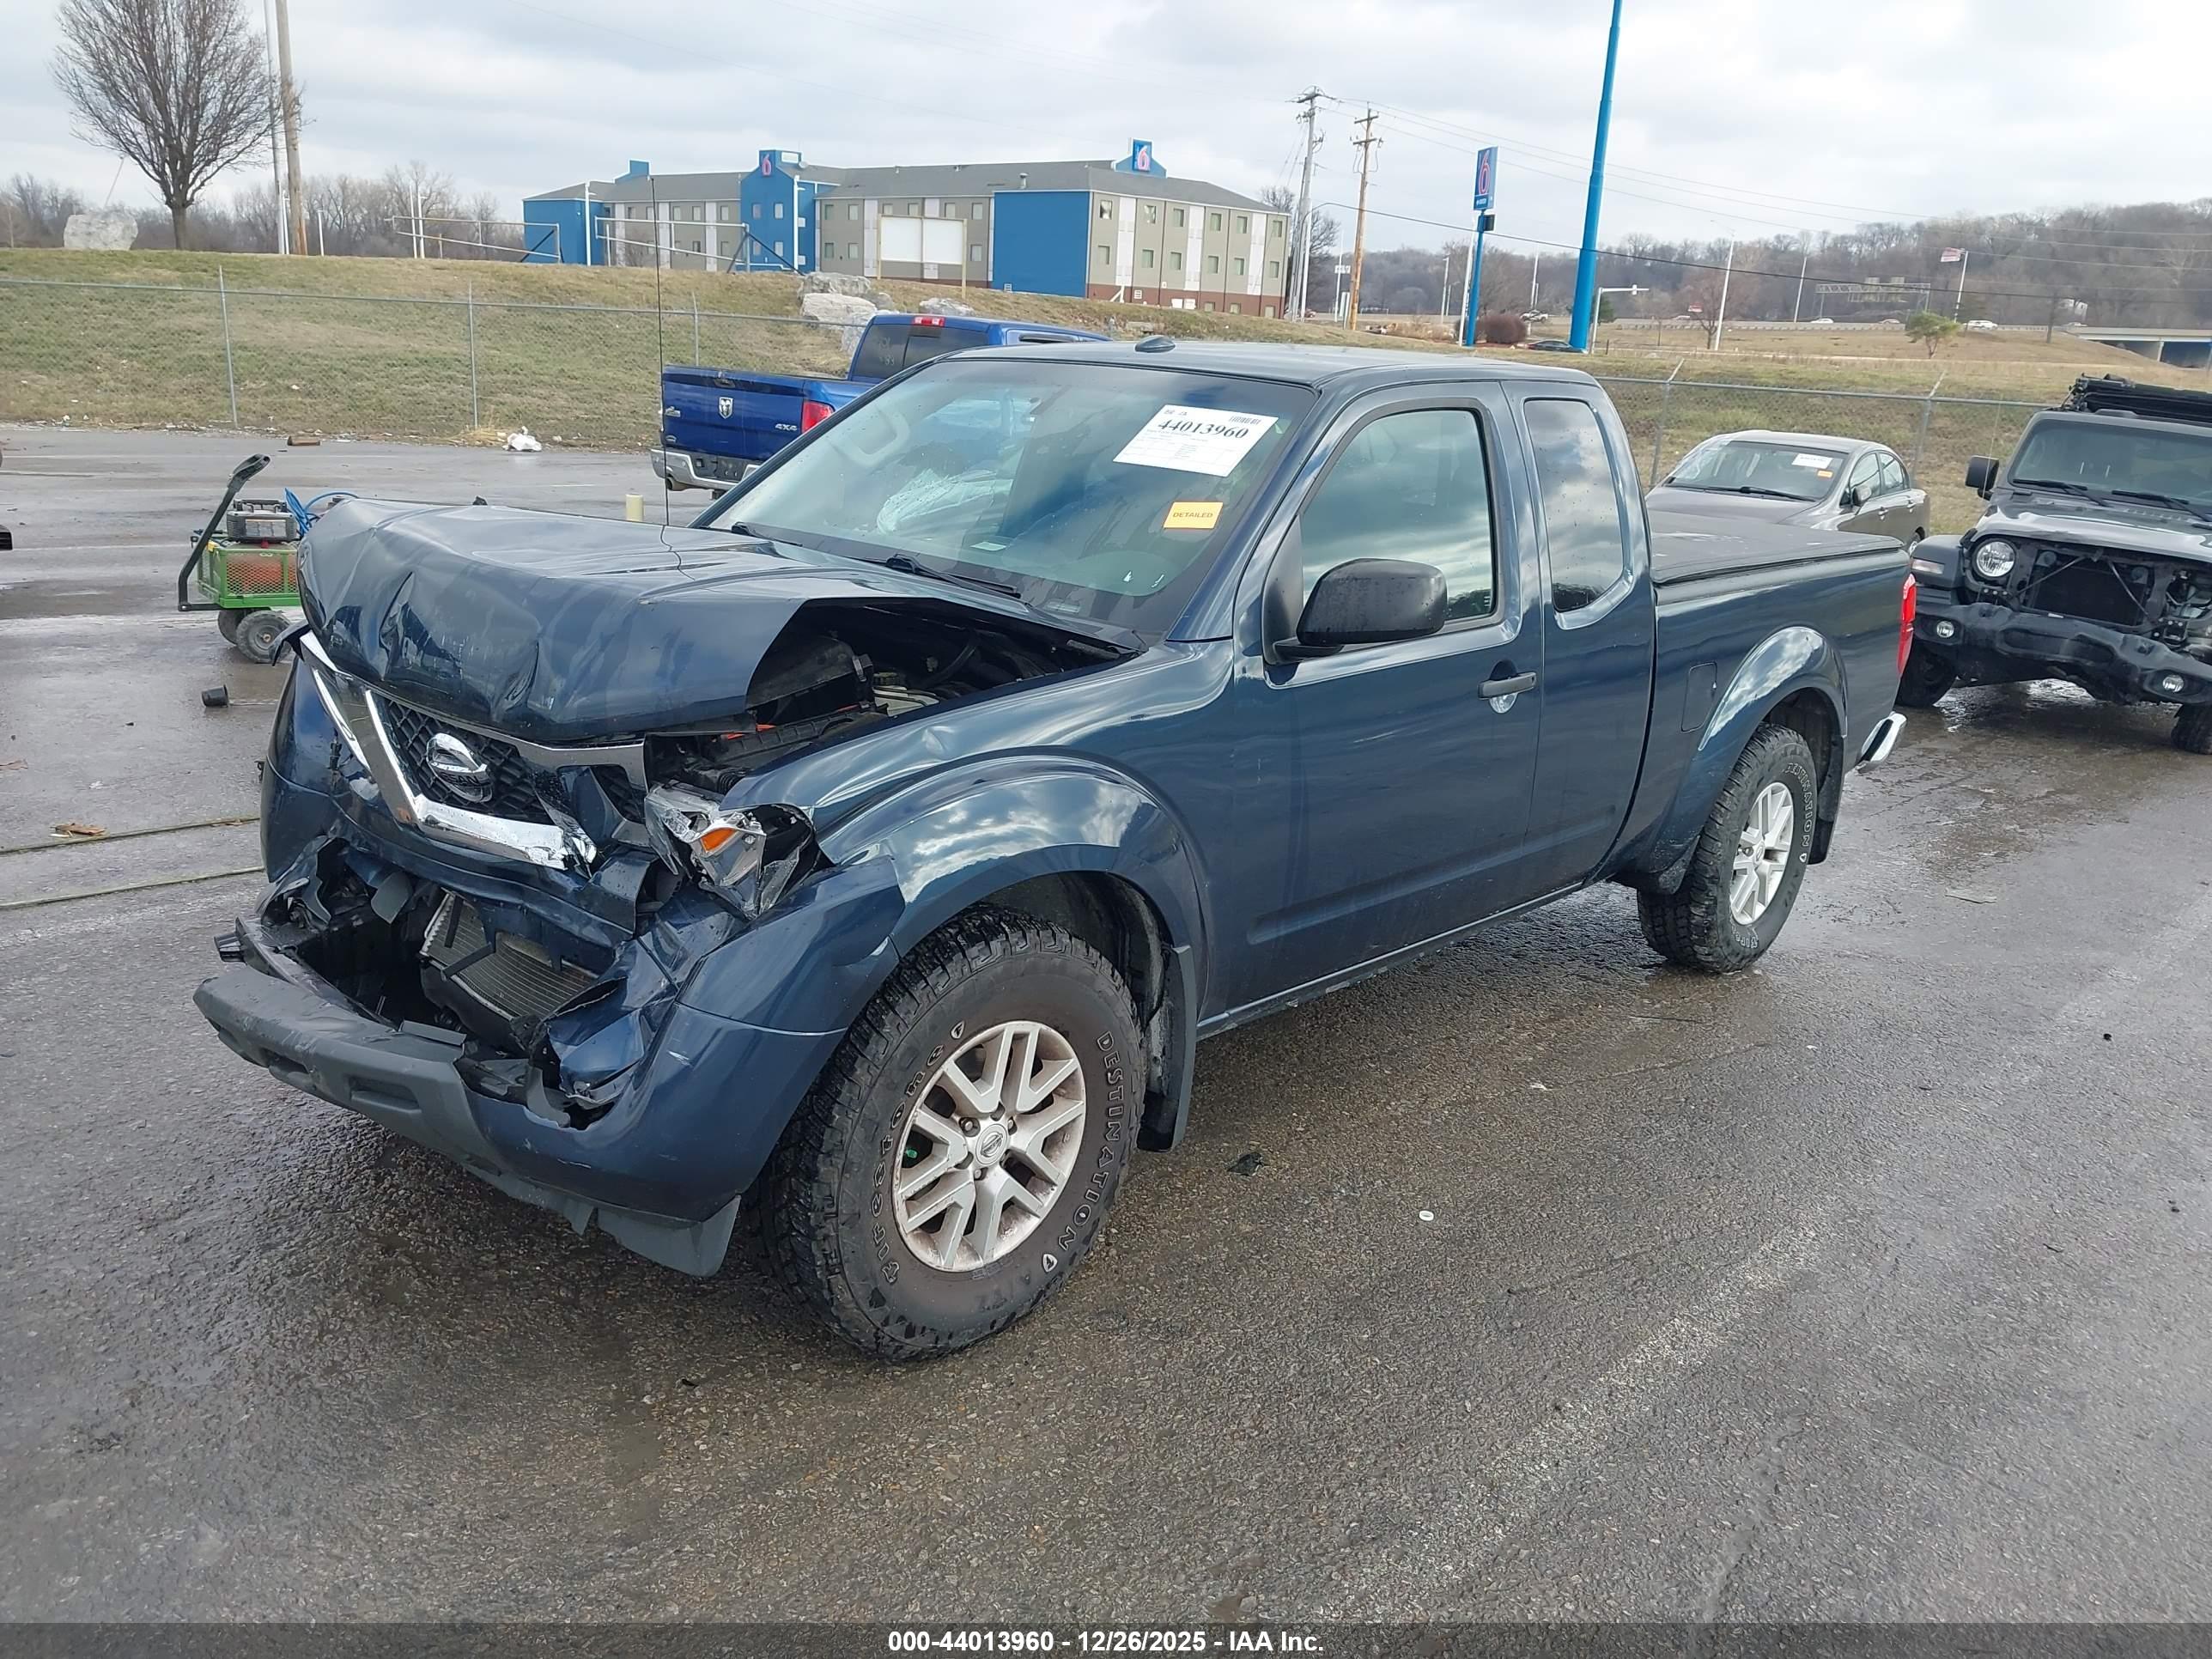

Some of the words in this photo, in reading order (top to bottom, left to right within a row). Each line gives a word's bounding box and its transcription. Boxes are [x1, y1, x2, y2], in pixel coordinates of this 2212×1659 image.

[762, 153, 772, 176] 6
[1138, 144, 1150, 171] 6
[1478, 149, 1491, 196] 6
[1158, 419, 1249, 439] 44013960
[1058, 1030, 1125, 1252] DESTINATION
